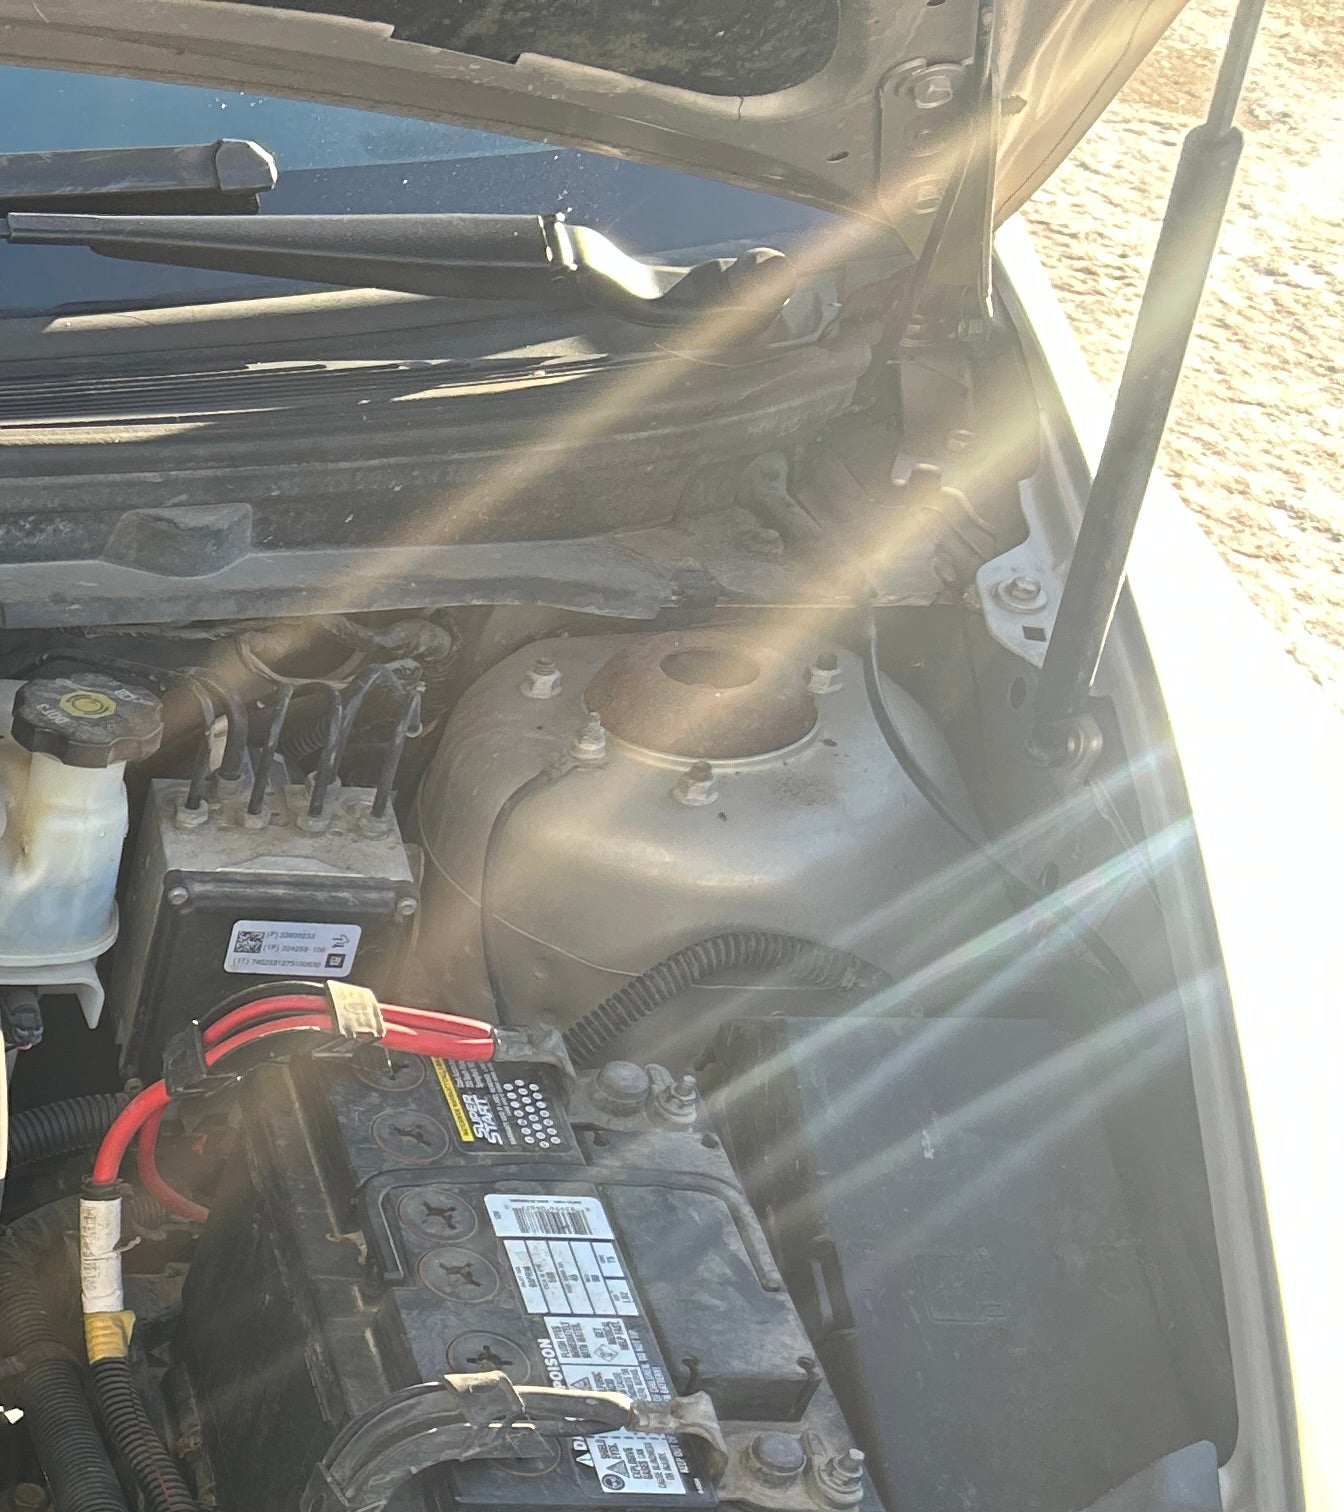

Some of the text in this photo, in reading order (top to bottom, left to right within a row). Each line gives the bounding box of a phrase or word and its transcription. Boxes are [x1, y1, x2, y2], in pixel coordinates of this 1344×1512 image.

[462, 1094, 484, 1138] SUPER
[472, 1095, 503, 1145] START
[537, 1338, 566, 1388] POISON
